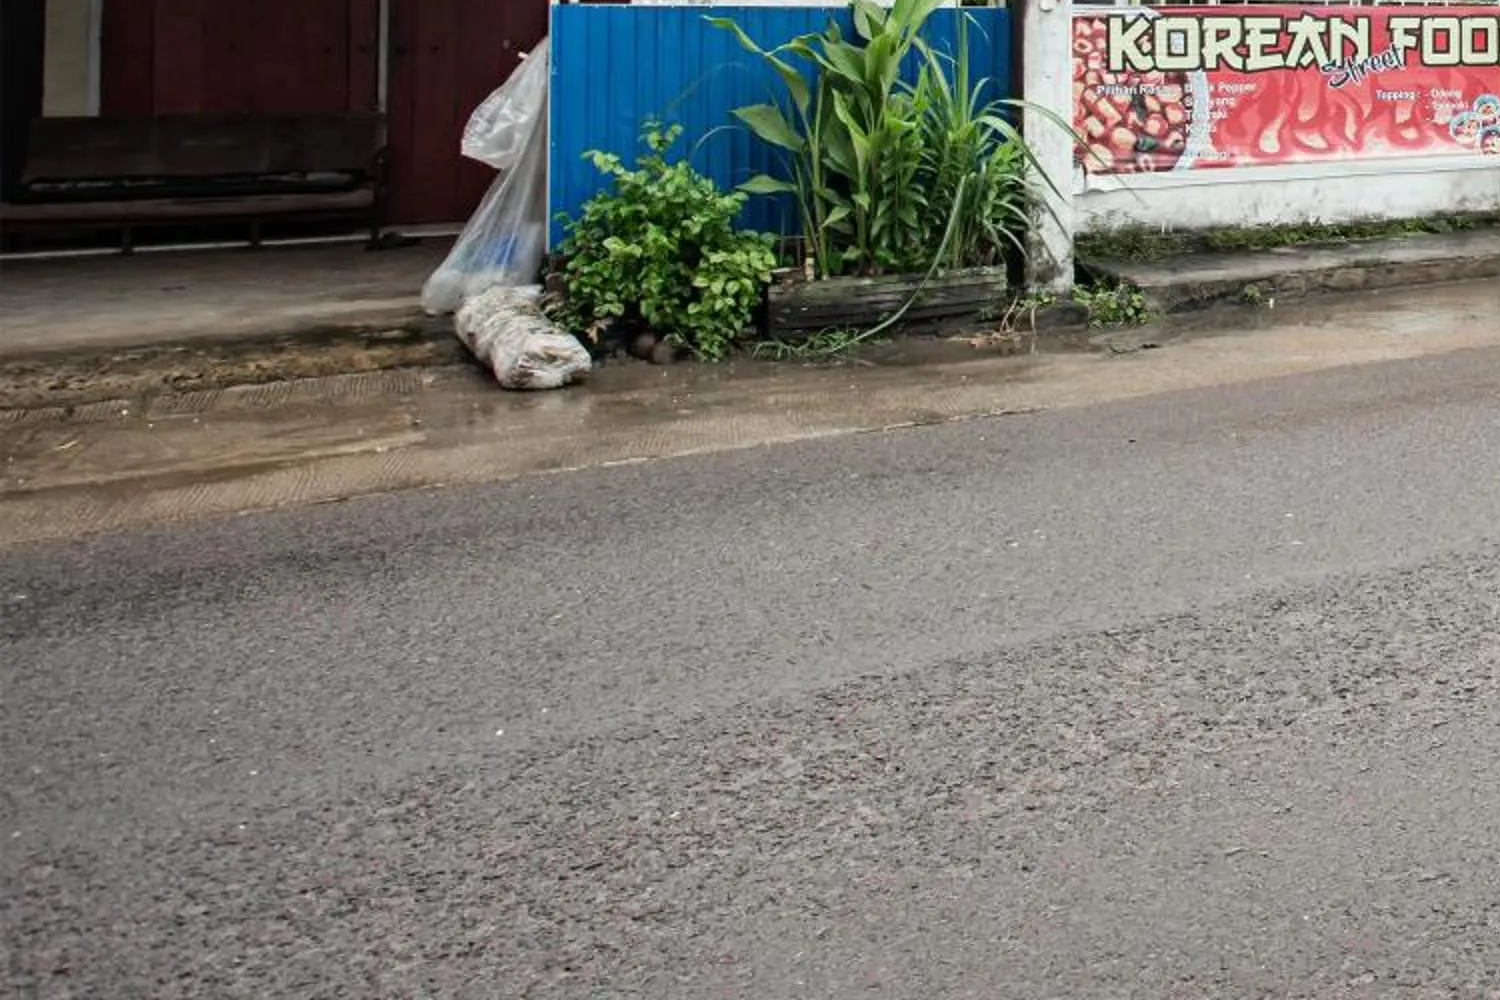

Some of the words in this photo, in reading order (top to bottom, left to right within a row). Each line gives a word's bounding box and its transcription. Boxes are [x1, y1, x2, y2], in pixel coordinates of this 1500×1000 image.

[1106, 13, 1372, 74] KOREAN
[1322, 43, 1407, 88] Street
[1097, 83, 1137, 97] Pilihan
[1218, 81, 1257, 95] Pepper
[1375, 88, 1414, 102] Topping
